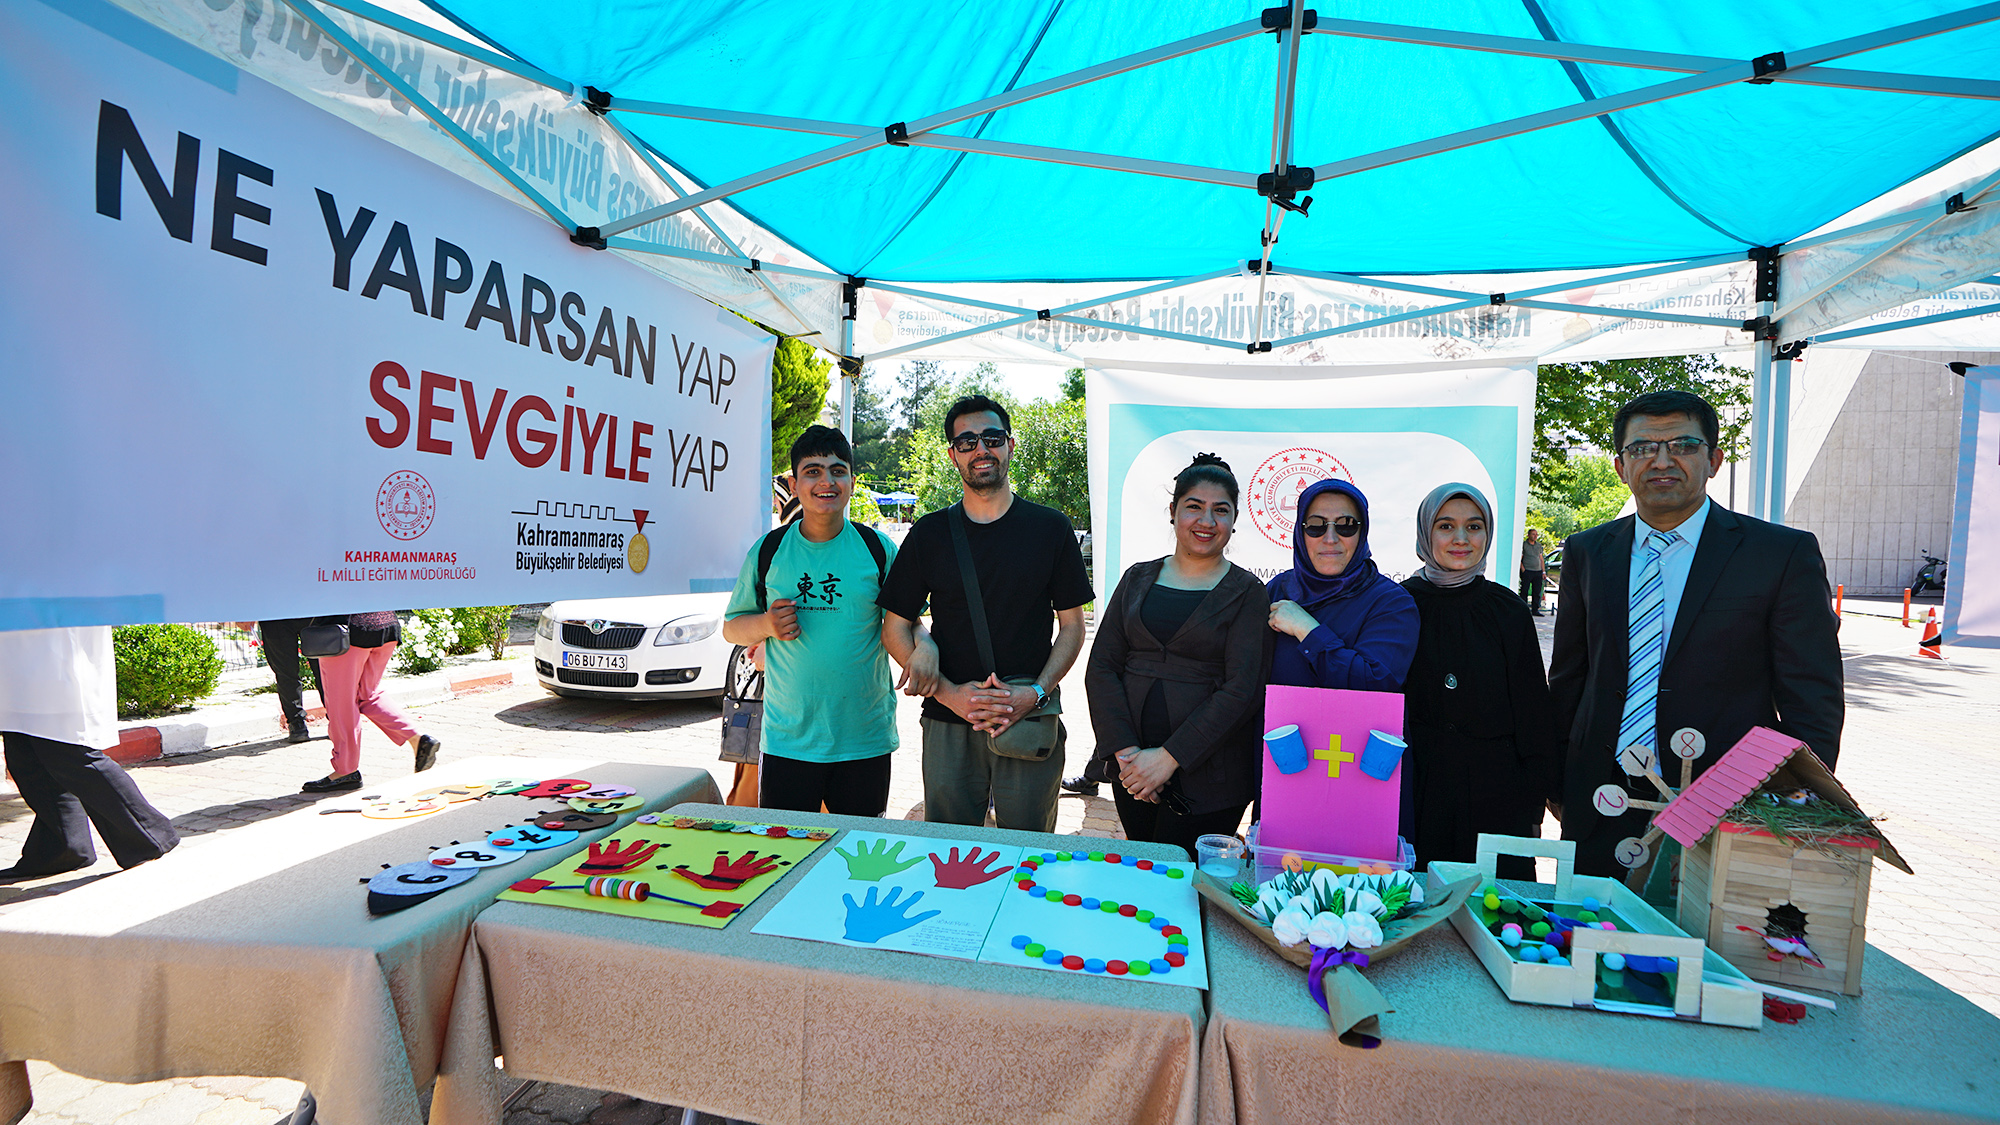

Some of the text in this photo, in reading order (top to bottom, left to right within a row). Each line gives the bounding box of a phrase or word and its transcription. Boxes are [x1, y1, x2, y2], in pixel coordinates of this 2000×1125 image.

[96, 99, 736, 414] NE YAPARSAN YAP,
[365, 360, 729, 493] SEVGİYLE YAP
[517, 522, 624, 551] Kahramanmaraş
[345, 551, 457, 565] KAHRAMANMARAŞ
[516, 551, 624, 575] Büyükşehir Belediyesi
[317, 566, 476, 582] İL MİLLÎ EĞİTİM MÜDÜRLÜĞÜ
[794, 572, 843, 605] 東京
[568, 653, 625, 669] 06 BU 7143
[1680, 731, 1696, 758] 8
[548, 783, 572, 792] 3
[1597, 791, 1624, 809] 2
[517, 829, 551, 844] 7
[455, 850, 497, 862] 8
[1617, 842, 1644, 865] 3
[396, 873, 448, 885] 9
